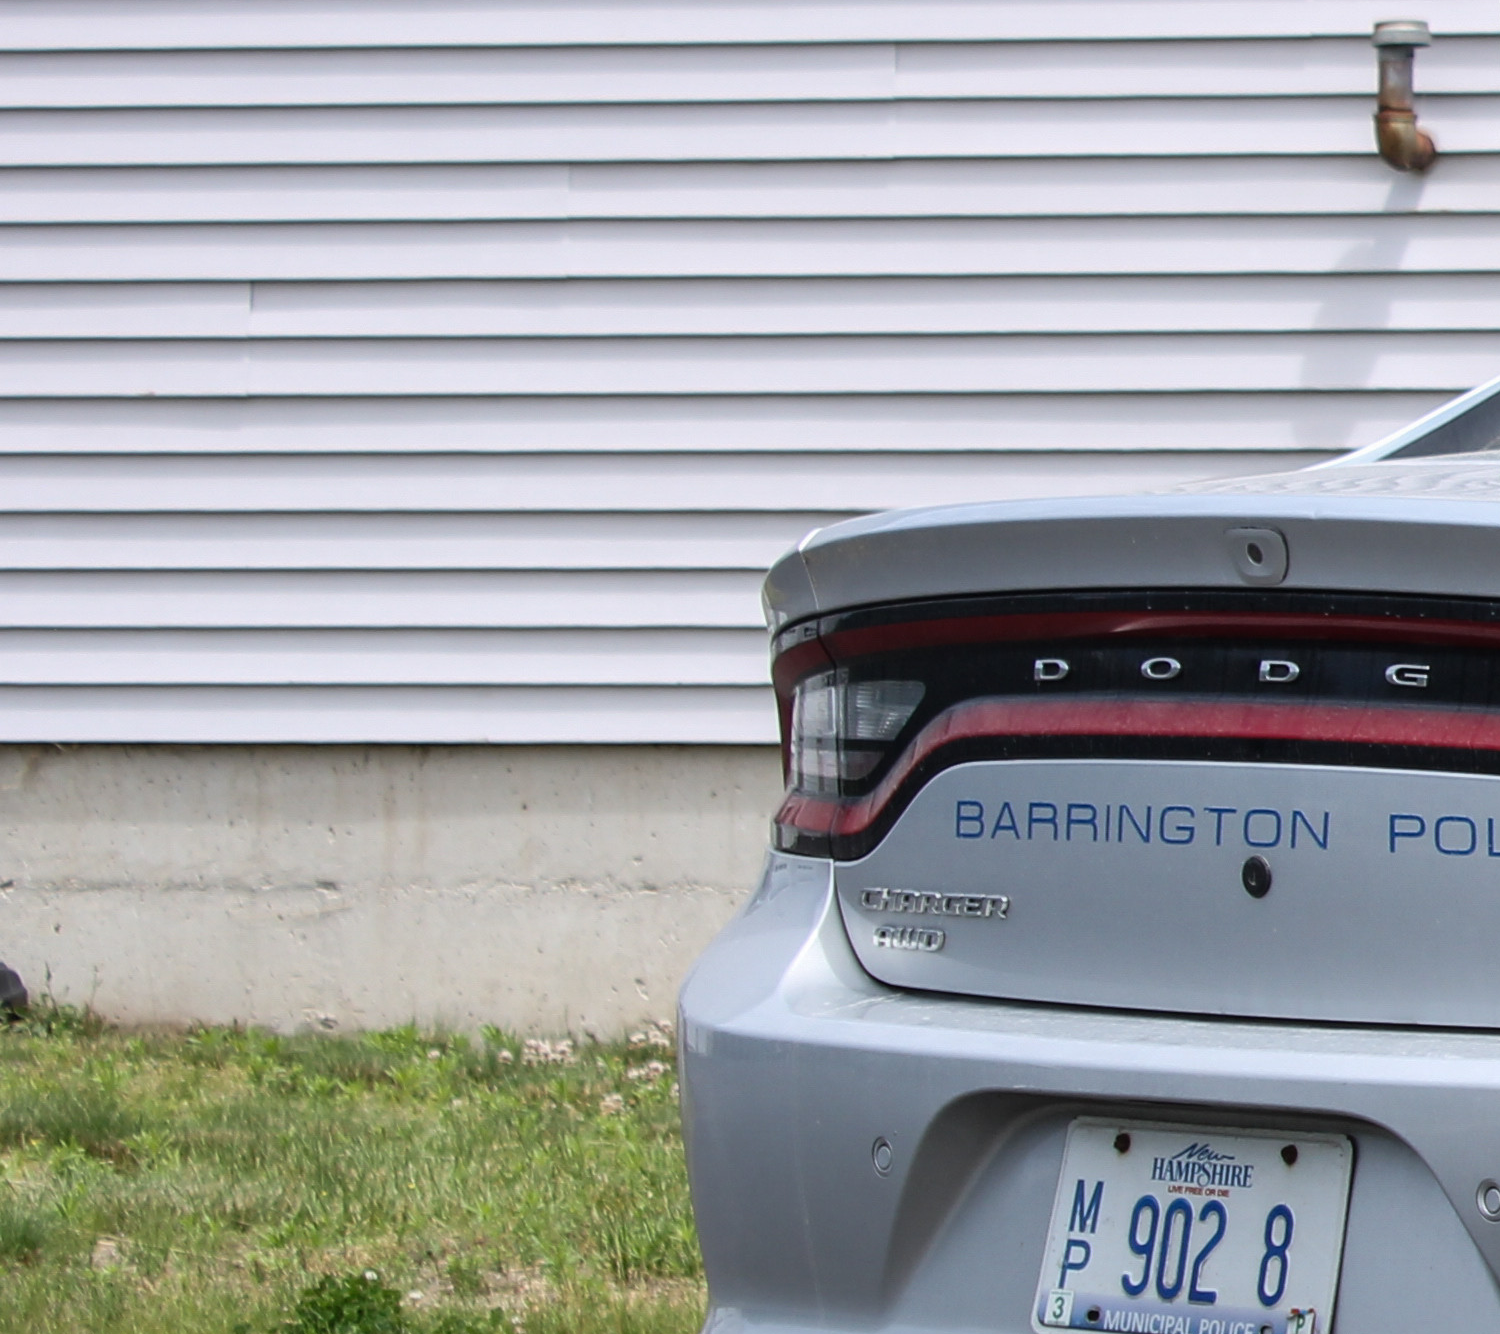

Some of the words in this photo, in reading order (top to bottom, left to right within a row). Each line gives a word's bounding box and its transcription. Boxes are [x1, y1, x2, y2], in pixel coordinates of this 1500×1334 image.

[954, 799, 1331, 851] BARRINGTON
[859, 886, 1011, 919] CHARGER
[872, 923, 946, 953] AWD
[1171, 1141, 1236, 1161] New
[1151, 1157, 1255, 1188] HAMPSHIRE
[1167, 1185, 1184, 1195] LIVE
[1184, 1186, 1203, 1196] FREE
[1204, 1188, 1216, 1197] OR
[1217, 1189, 1230, 1198] DIE
[1120, 1193, 1228, 1305] 902
[1256, 1203, 1295, 1307] 8
[1052, 1297, 1065, 1320] 3
